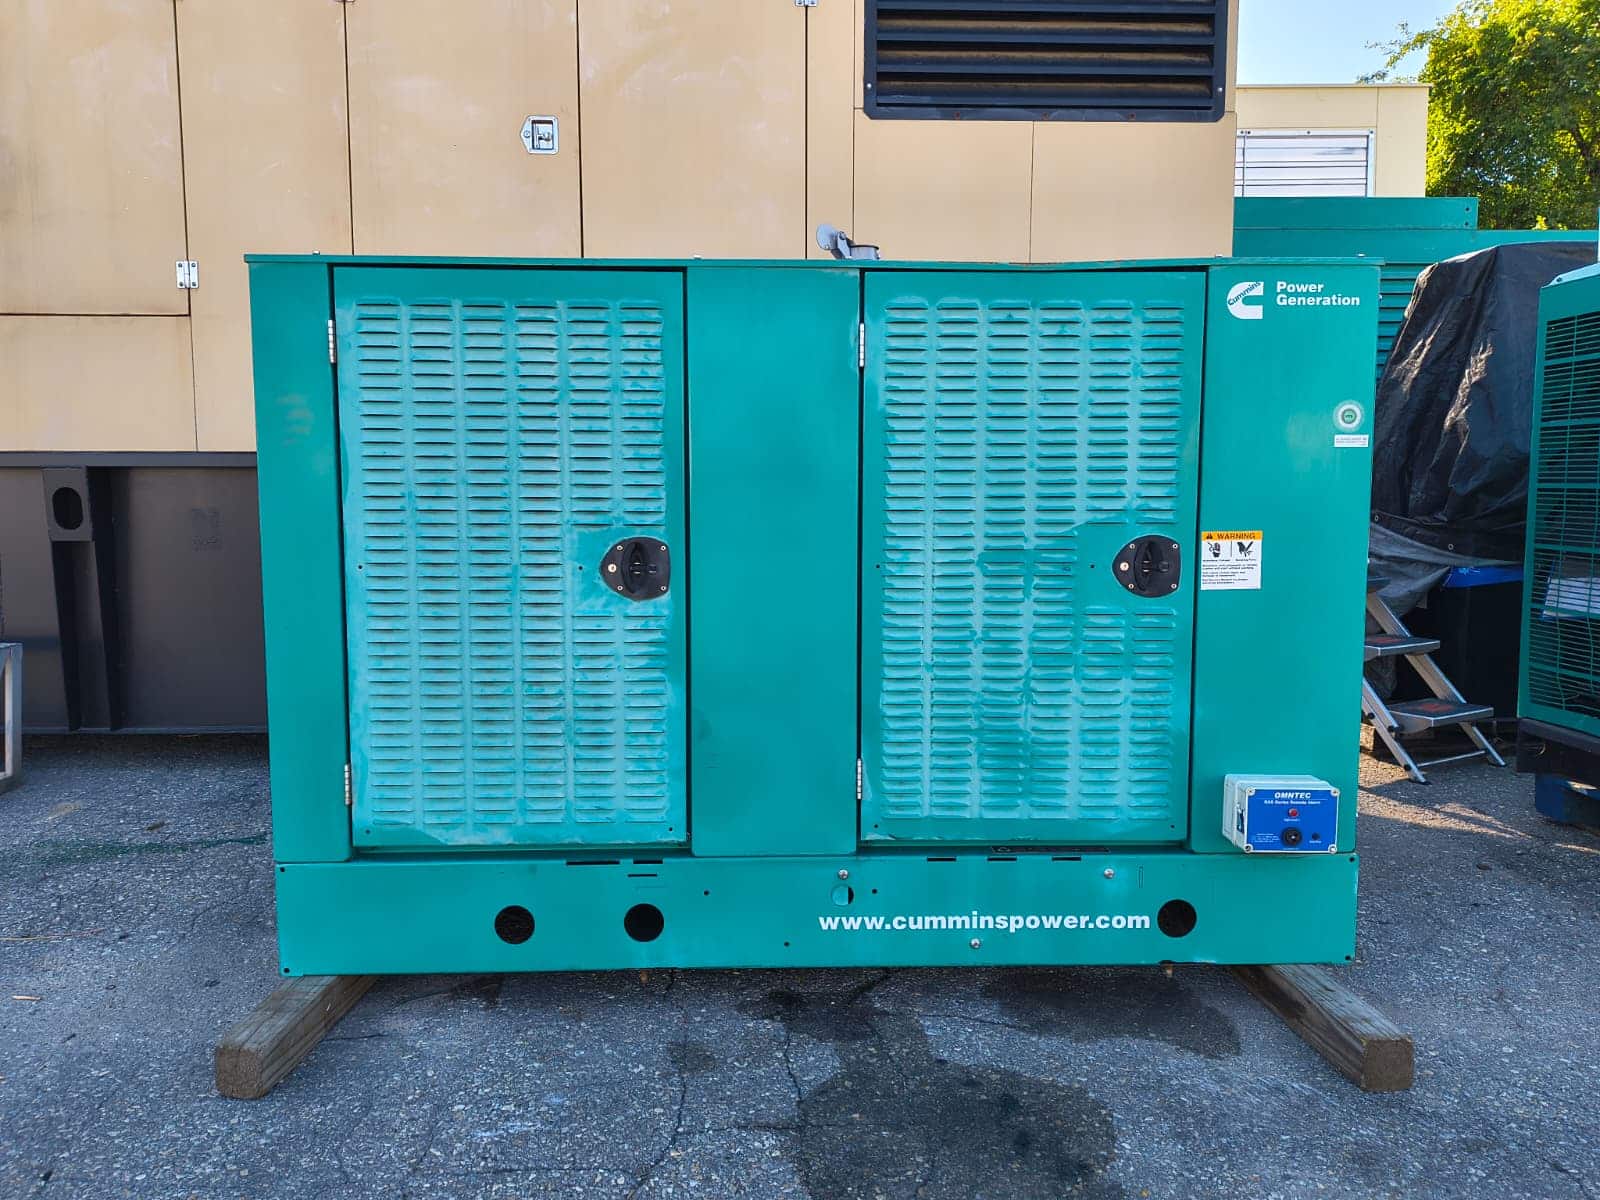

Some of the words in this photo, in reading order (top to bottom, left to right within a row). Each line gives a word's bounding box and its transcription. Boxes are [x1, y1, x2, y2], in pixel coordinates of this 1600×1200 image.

[1228, 281, 1261, 305] Cummins
[1276, 281, 1324, 293] Power
[1276, 294, 1360, 306] Generation
[1217, 531, 1257, 540] WARNING
[1274, 791, 1311, 799] OMNTEC
[818, 911, 1151, 933] www.cumminspower.com
